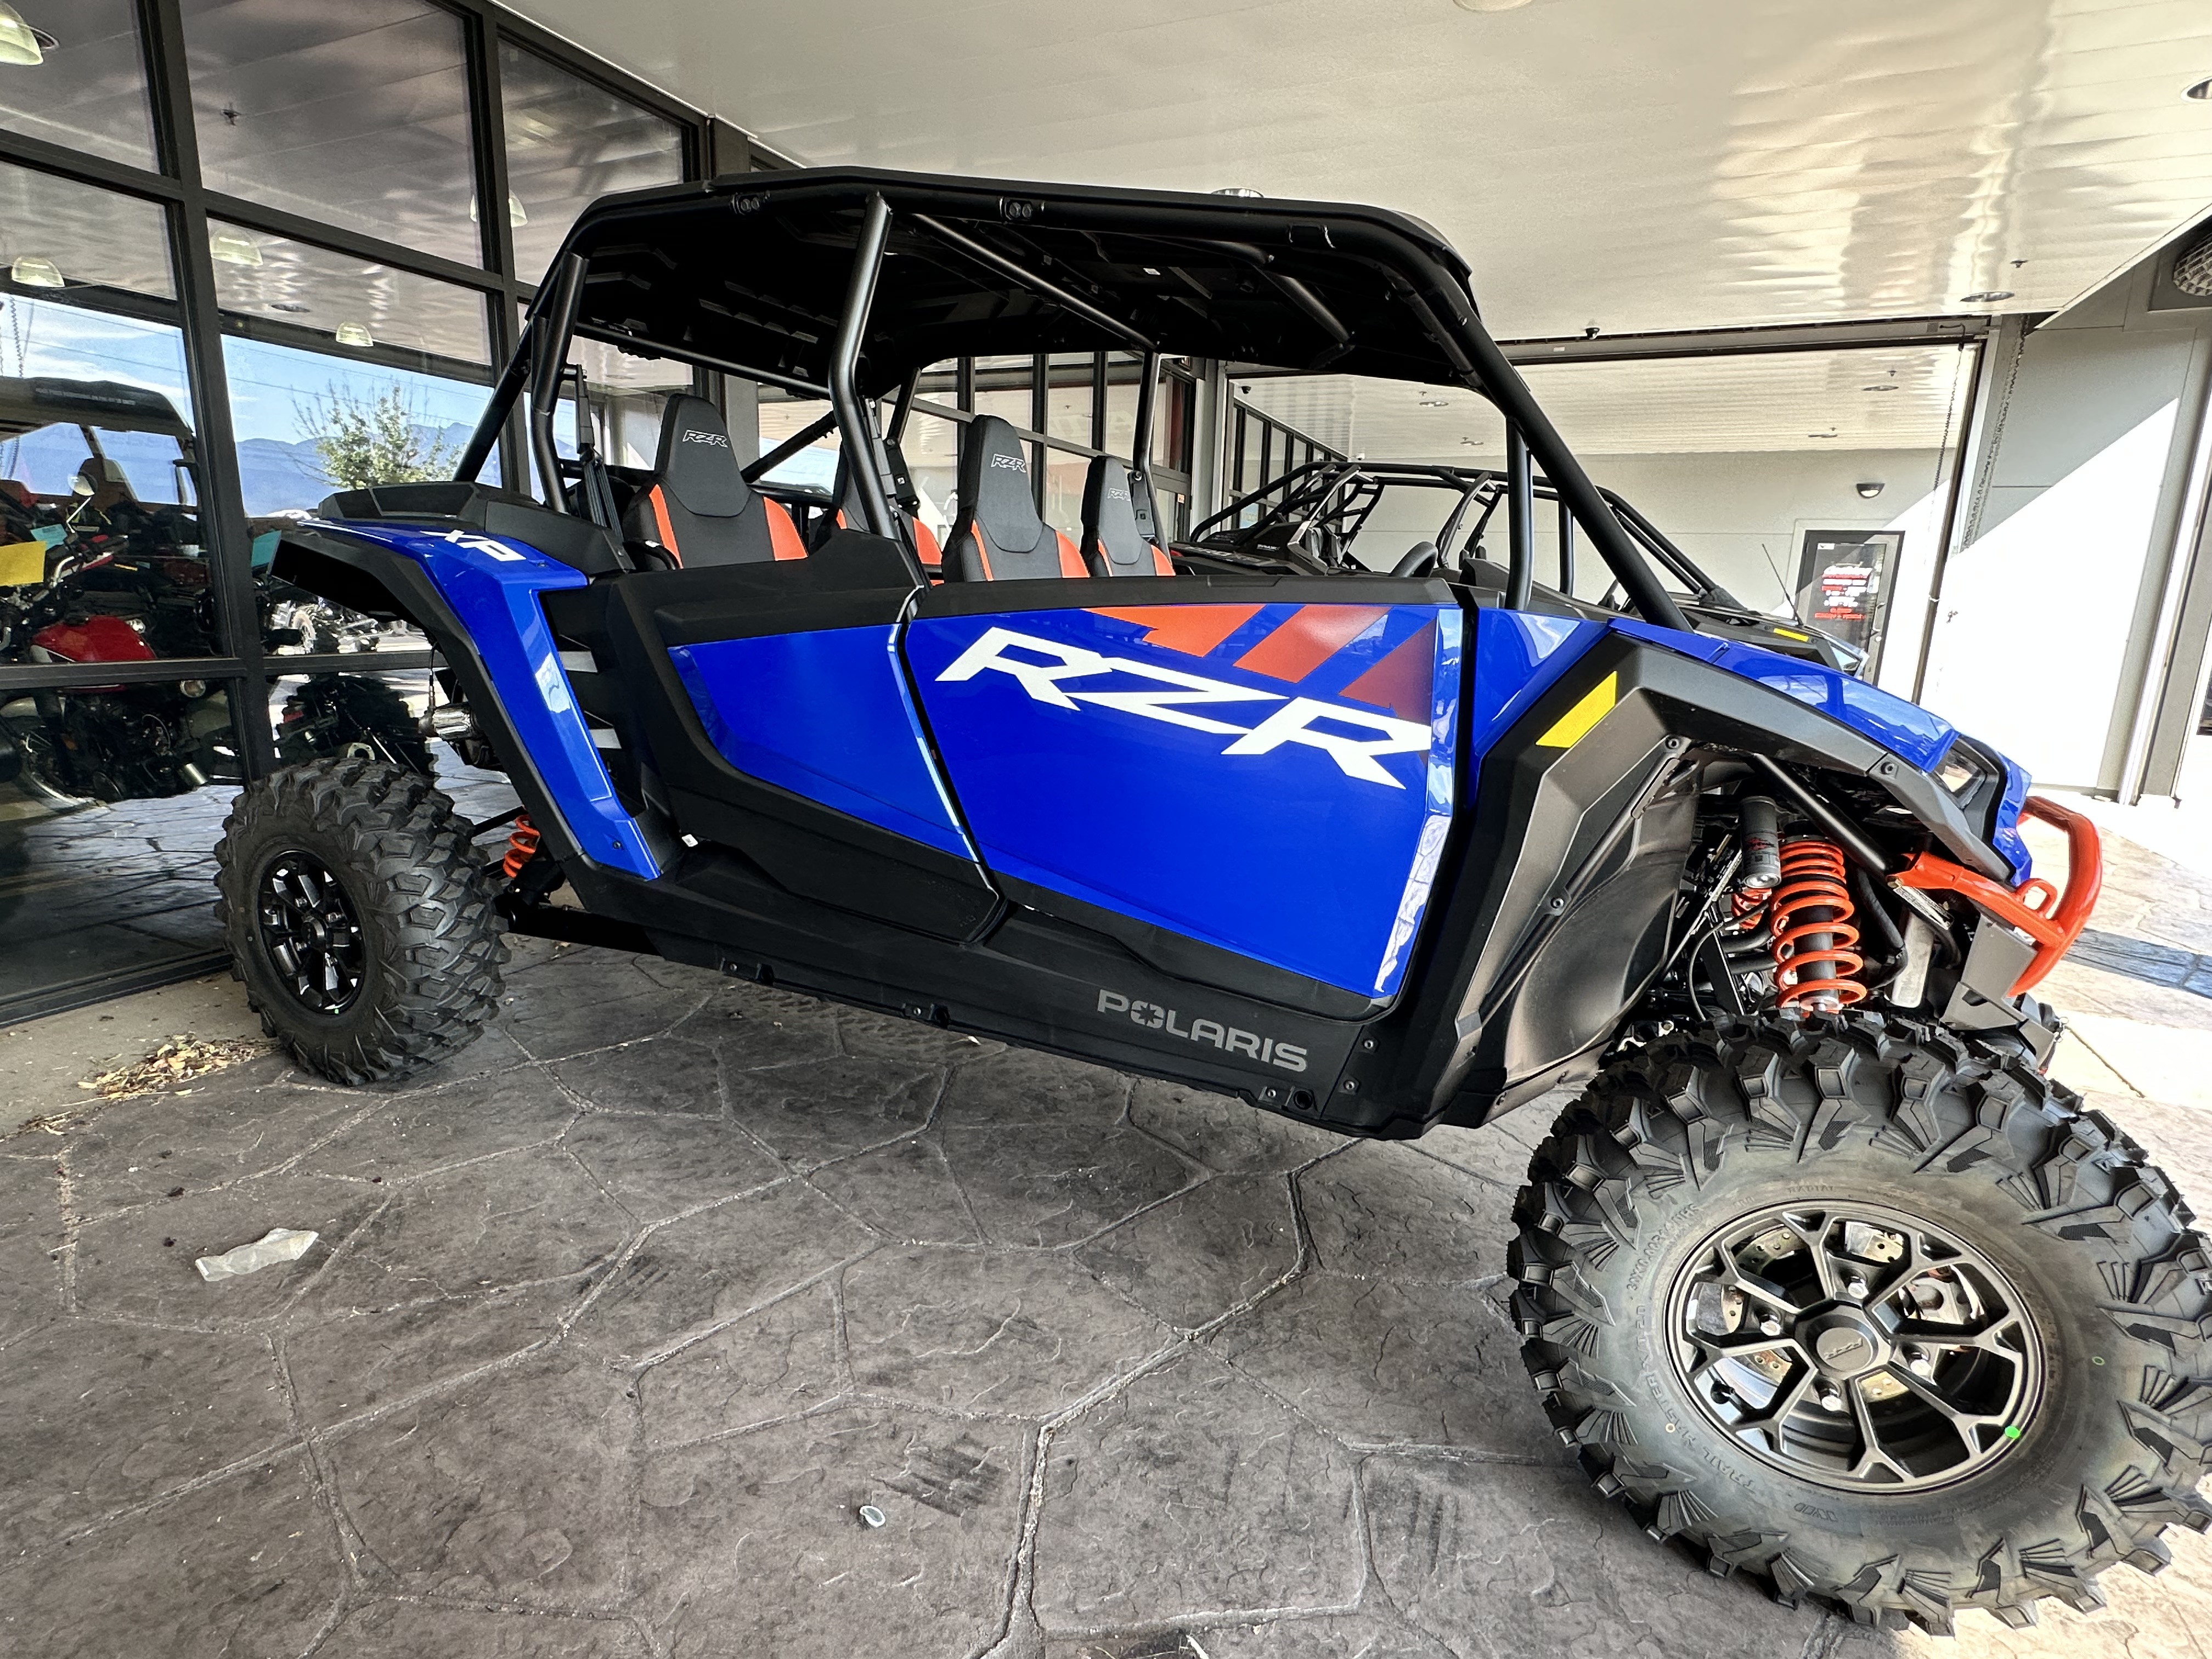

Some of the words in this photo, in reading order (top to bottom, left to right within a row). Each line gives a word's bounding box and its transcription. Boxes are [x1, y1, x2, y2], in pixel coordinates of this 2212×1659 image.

[682, 429, 728, 448] RZR
[990, 453, 1026, 473] RZR
[1107, 487, 1131, 501] RZR
[419, 529, 527, 562] XP
[934, 626, 1432, 790] RZR
[1097, 989, 1308, 1073] POLARIS
[1646, 1372, 1697, 1451] MASTER
[1703, 1447, 1756, 1493] TRAIL
